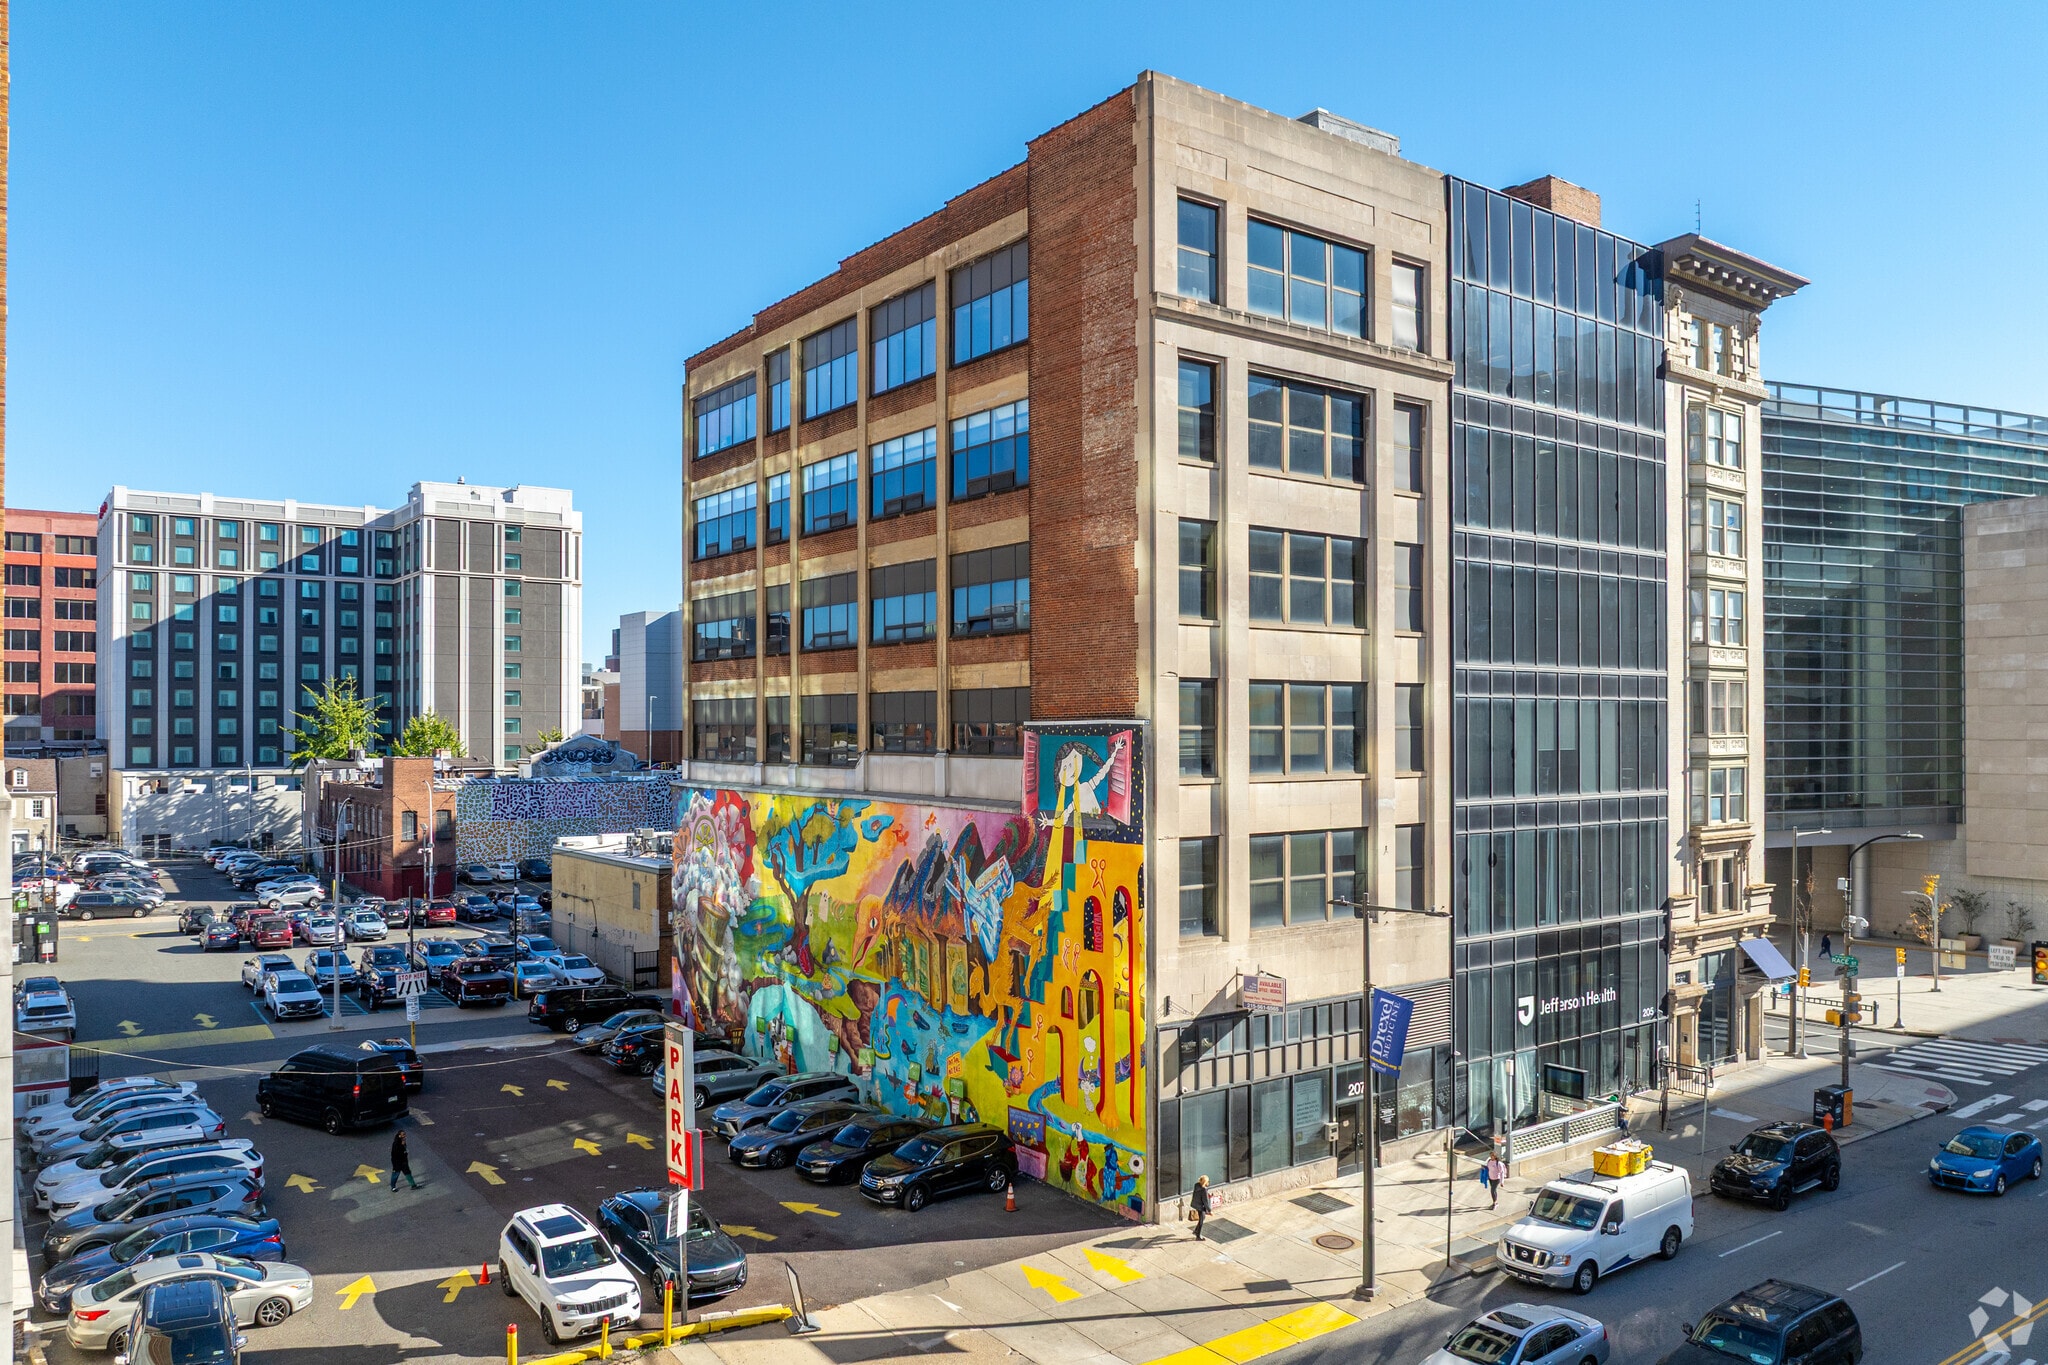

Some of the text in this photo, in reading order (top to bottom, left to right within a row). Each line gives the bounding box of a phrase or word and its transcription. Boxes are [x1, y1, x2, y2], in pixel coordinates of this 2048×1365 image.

[1831, 957, 1850, 965] RACE
[413, 971, 426, 980] HERE
[1259, 981, 1282, 989] AVAILABLE
[1540, 987, 1616, 1015] Jefferson Health
[1642, 1006, 1655, 1018] 205
[1371, 997, 1395, 1057] Drexel
[1382, 1001, 1401, 1060] MEDICINE
[1348, 1081, 1365, 1097] 207
[670, 1045, 682, 1167] PARK
